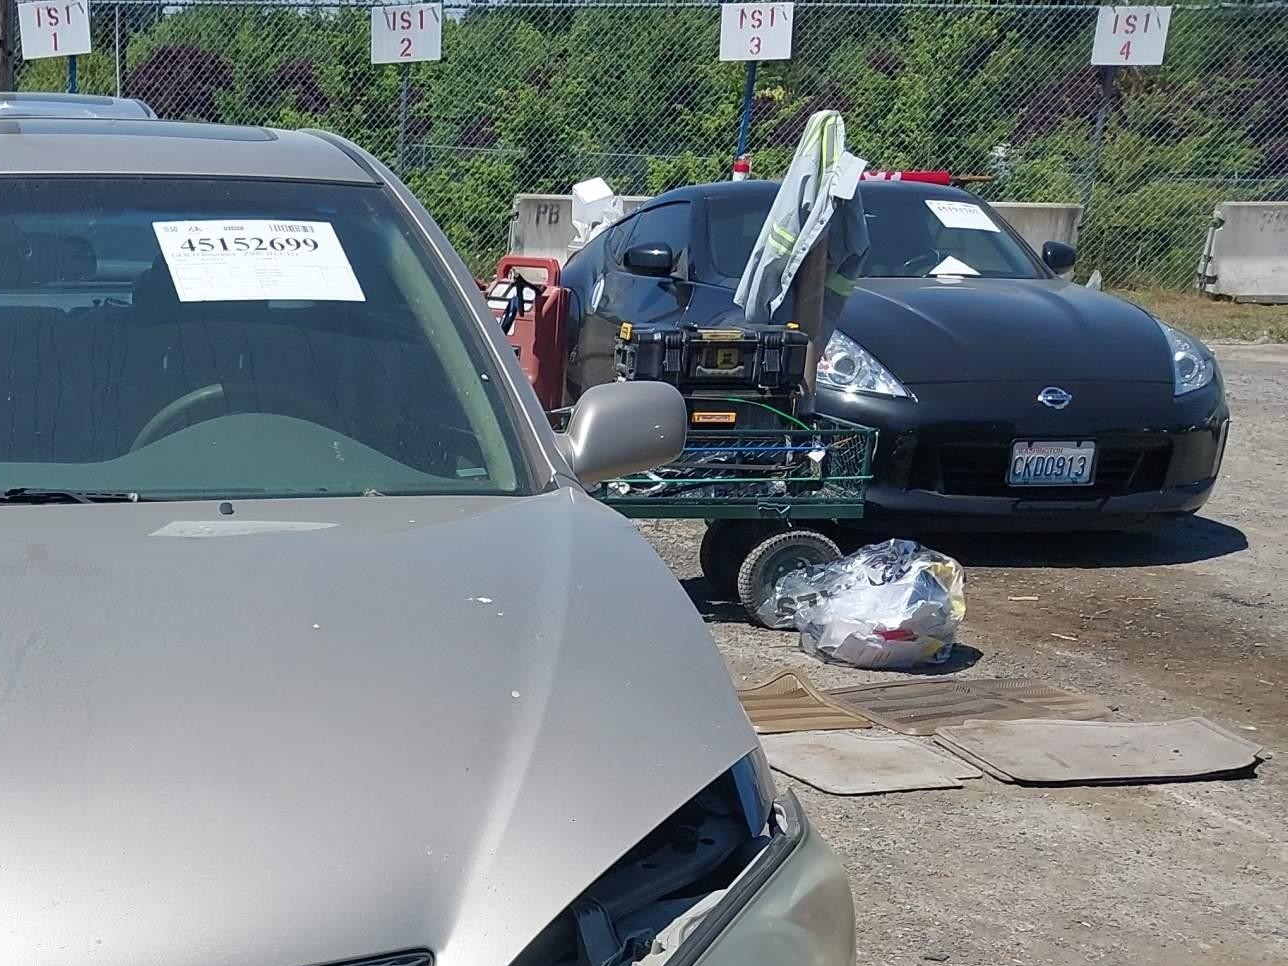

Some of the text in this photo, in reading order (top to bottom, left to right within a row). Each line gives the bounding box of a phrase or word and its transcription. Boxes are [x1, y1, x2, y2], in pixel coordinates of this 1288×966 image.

[52, 32, 58, 51] 1
[399, 37, 412, 57] 2
[749, 36, 761, 55] 3
[1119, 40, 1131, 60] 4
[535, 203, 560, 226] PB
[180, 237, 319, 252] 45152699
[1012, 454, 1087, 478] CKD0913
